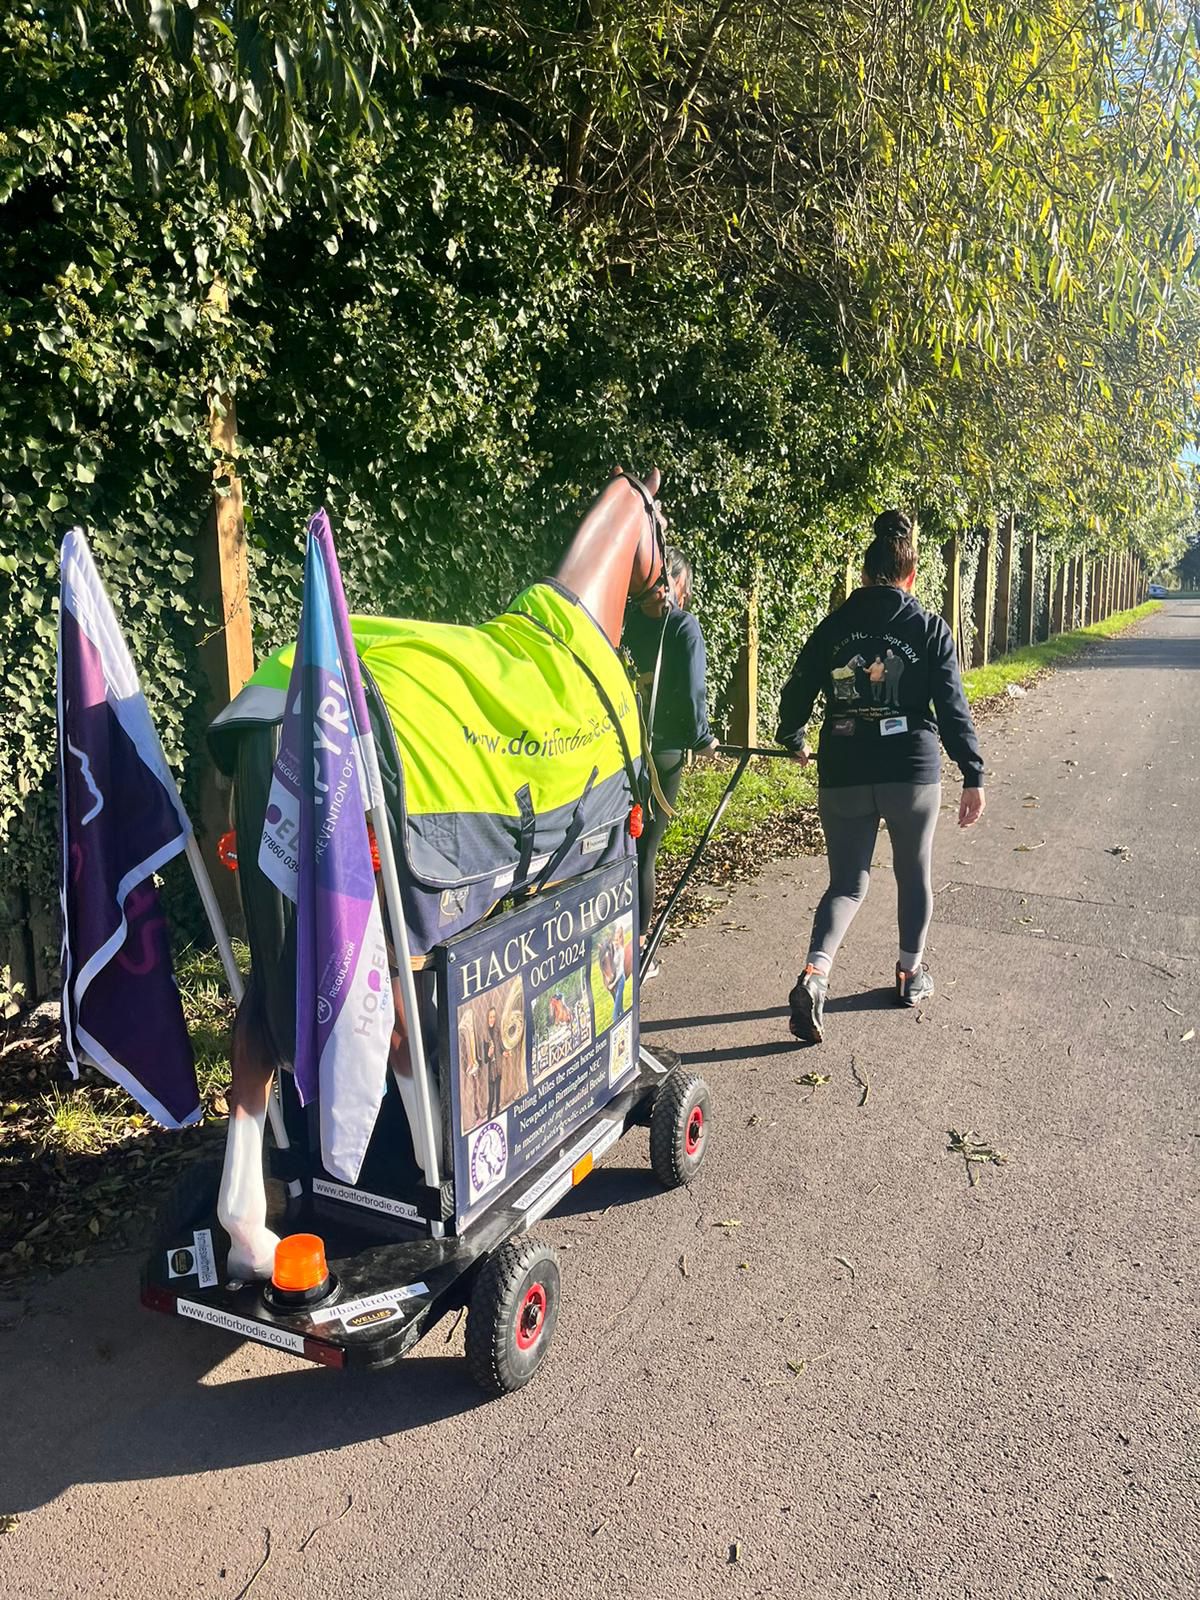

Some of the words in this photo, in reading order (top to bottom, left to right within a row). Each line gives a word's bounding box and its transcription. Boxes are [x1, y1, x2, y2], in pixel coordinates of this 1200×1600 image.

[882, 633, 902, 646] Sept
[901, 643, 920, 664] 2024
[342, 759, 354, 778] OF
[460, 927, 539, 1000] HACK
[543, 910, 574, 950] TO
[579, 877, 633, 933] HOYS
[328, 942, 356, 999] REGULATOR
[530, 954, 556, 988] OCT
[558, 939, 586, 971] 2024
[513, 1093, 538, 1118] Pulling
[538, 1080, 556, 1099] Miles
[555, 1072, 566, 1086] the
[566, 1060, 580, 1077] resin
[580, 1049, 595, 1066] horse
[595, 1039, 608, 1054] from
[519, 1103, 548, 1132] Newport
[548, 1099, 555, 1110] to
[555, 1070, 588, 1104] Birmingham
[589, 1057, 602, 1076] NEC
[513, 1144, 522, 1155] In
[522, 1121, 548, 1148] memory
[547, 1112, 557, 1126] of
[555, 1107, 566, 1121] my
[564, 1084, 589, 1110] beautiful
[589, 1071, 606, 1092] Brodie
[316, 1182, 419, 1218] www.doitforbrodie.co.uk
[181, 1303, 298, 1348] www.doitforbrodie.co.uk
[352, 1309, 392, 1324] WELLIES
